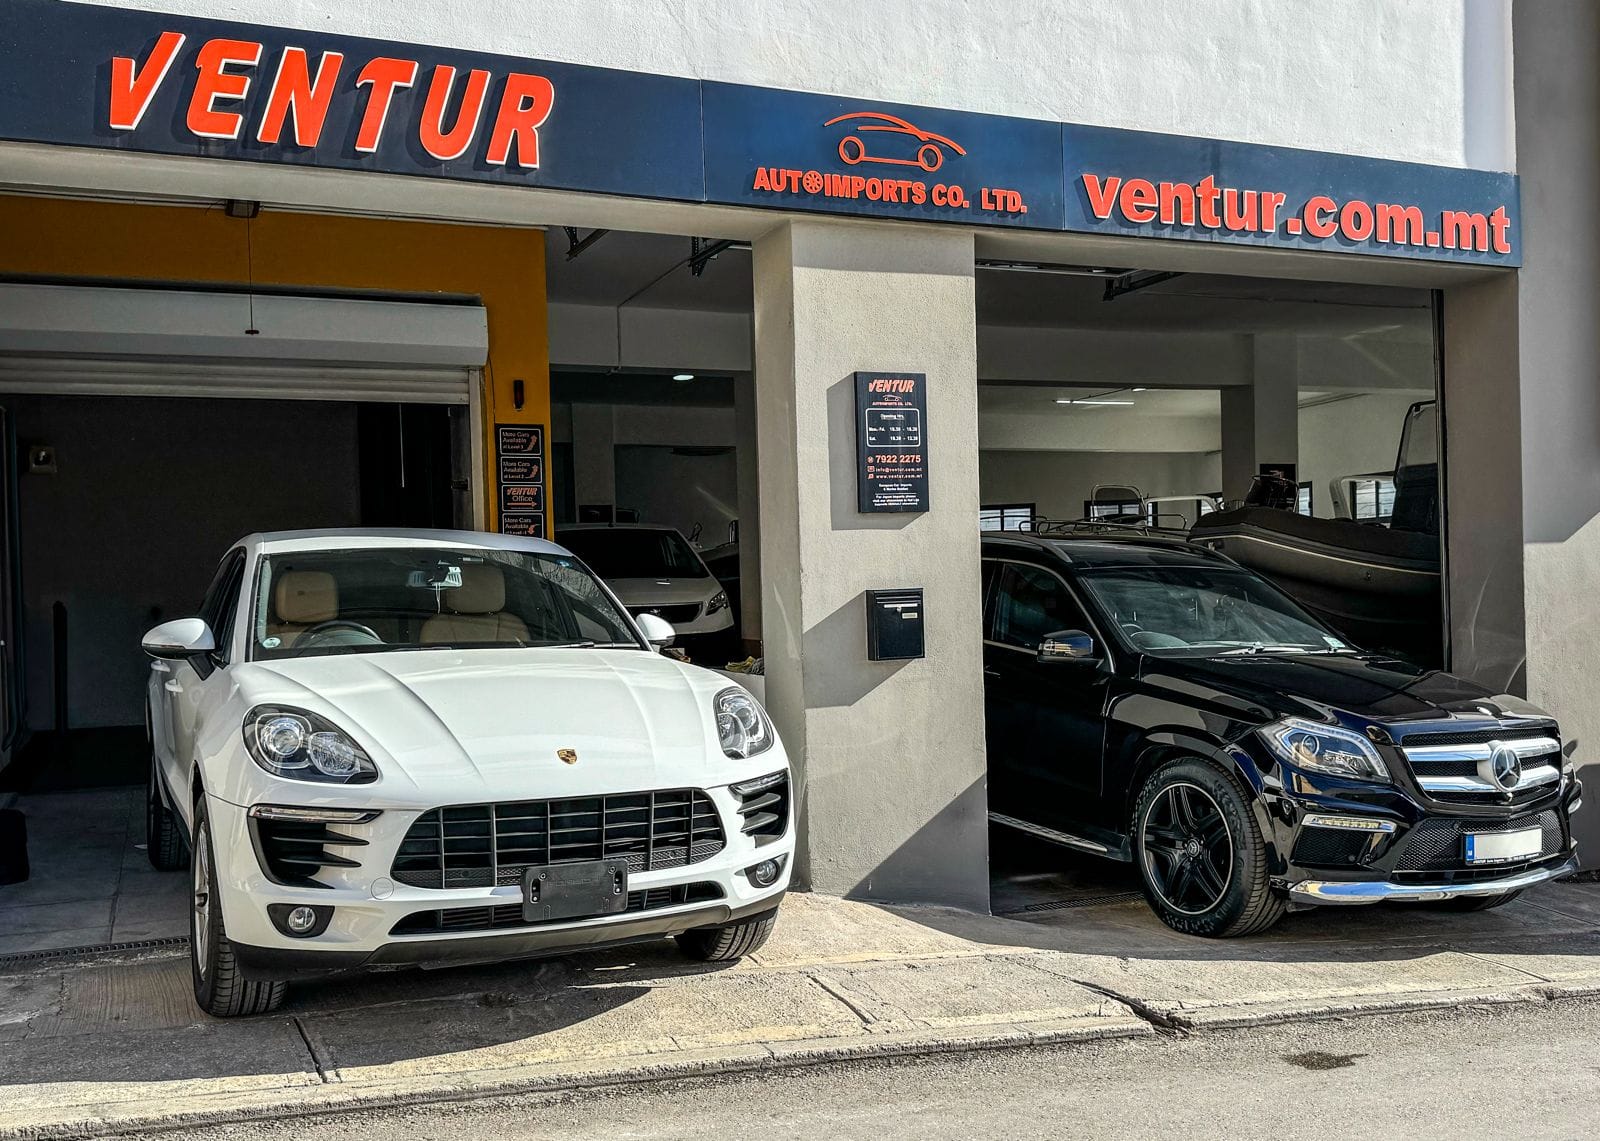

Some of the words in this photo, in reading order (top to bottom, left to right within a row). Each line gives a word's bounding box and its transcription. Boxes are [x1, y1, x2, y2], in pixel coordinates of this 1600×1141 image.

[109, 31, 555, 169] VENTUR
[932, 183, 969, 208] CO.
[981, 187, 1027, 213] LTD.
[1081, 174, 1511, 254] ventur.com.mt
[868, 379, 915, 393] VENTUR
[875, 454, 898, 464] 7922
[899, 454, 922, 464] 2275
[506, 487, 538, 496] VENTUR
